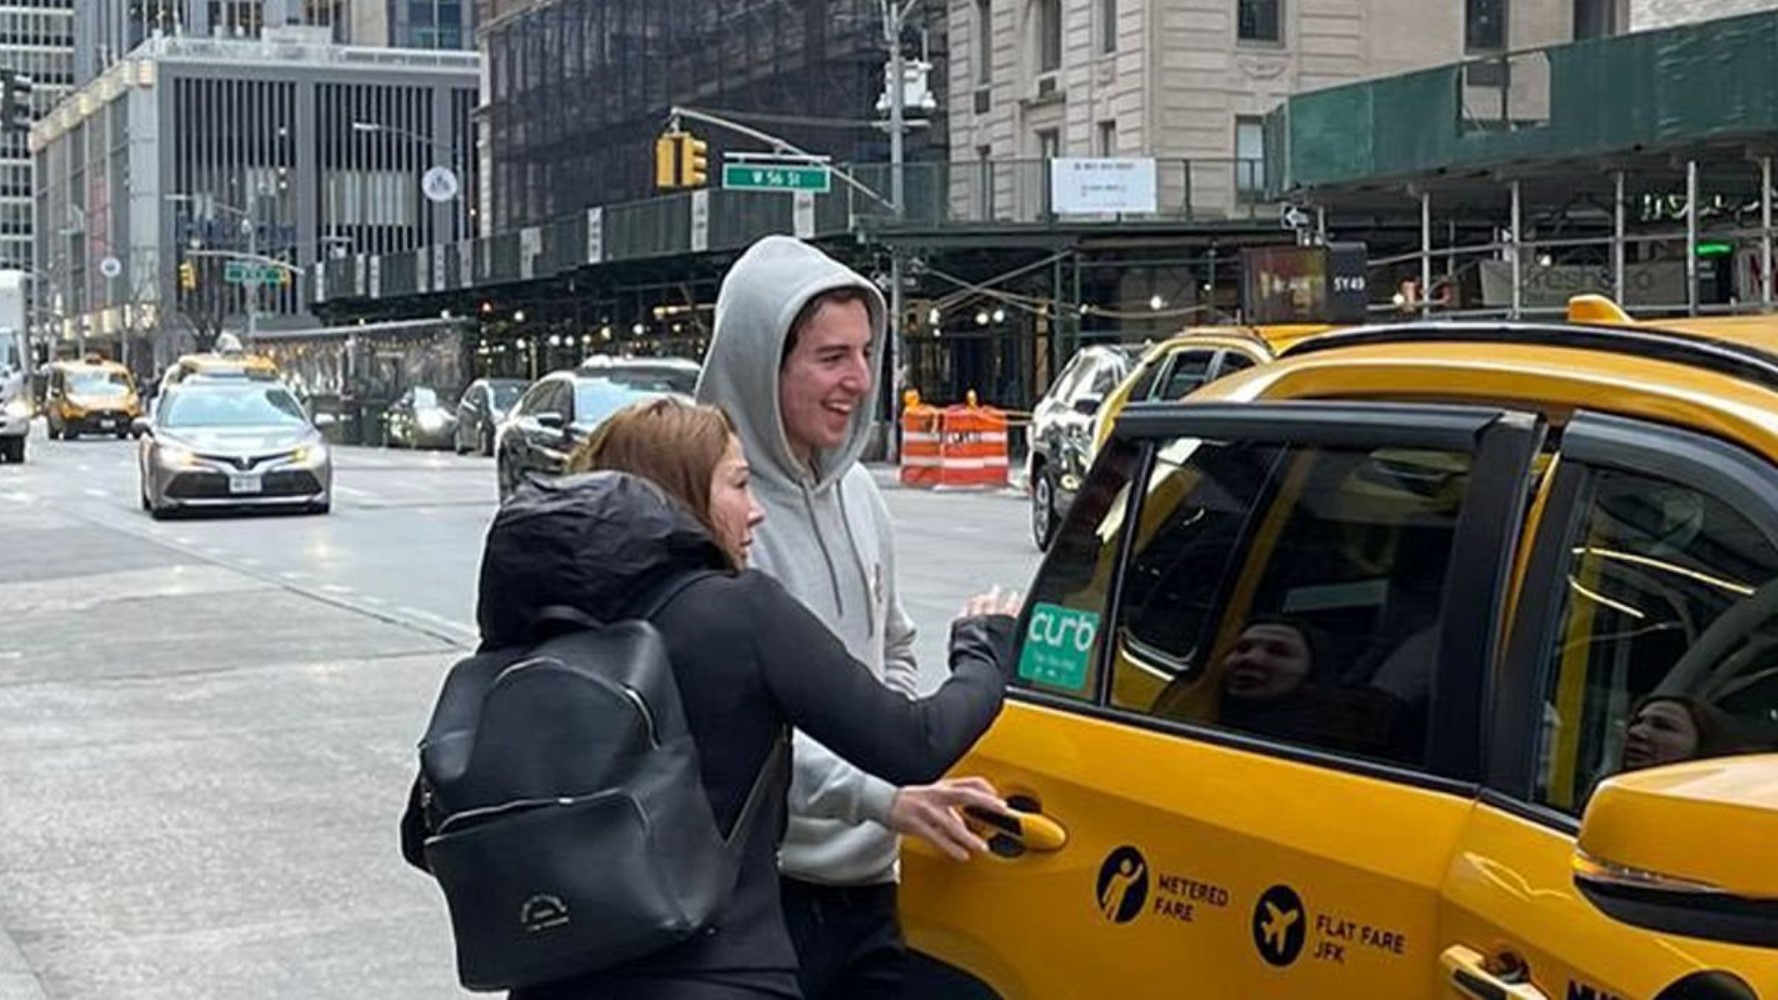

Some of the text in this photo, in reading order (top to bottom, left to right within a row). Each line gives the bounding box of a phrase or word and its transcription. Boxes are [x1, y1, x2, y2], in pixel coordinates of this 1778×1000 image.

[752, 170, 763, 184] W
[767, 171, 782, 186] 56
[1029, 611, 1094, 652] curb
[1158, 873, 1228, 907] METERED
[1154, 898, 1194, 922] FARE
[1315, 914, 1405, 955] FLAT FARE
[1314, 943, 1345, 964] JFK
